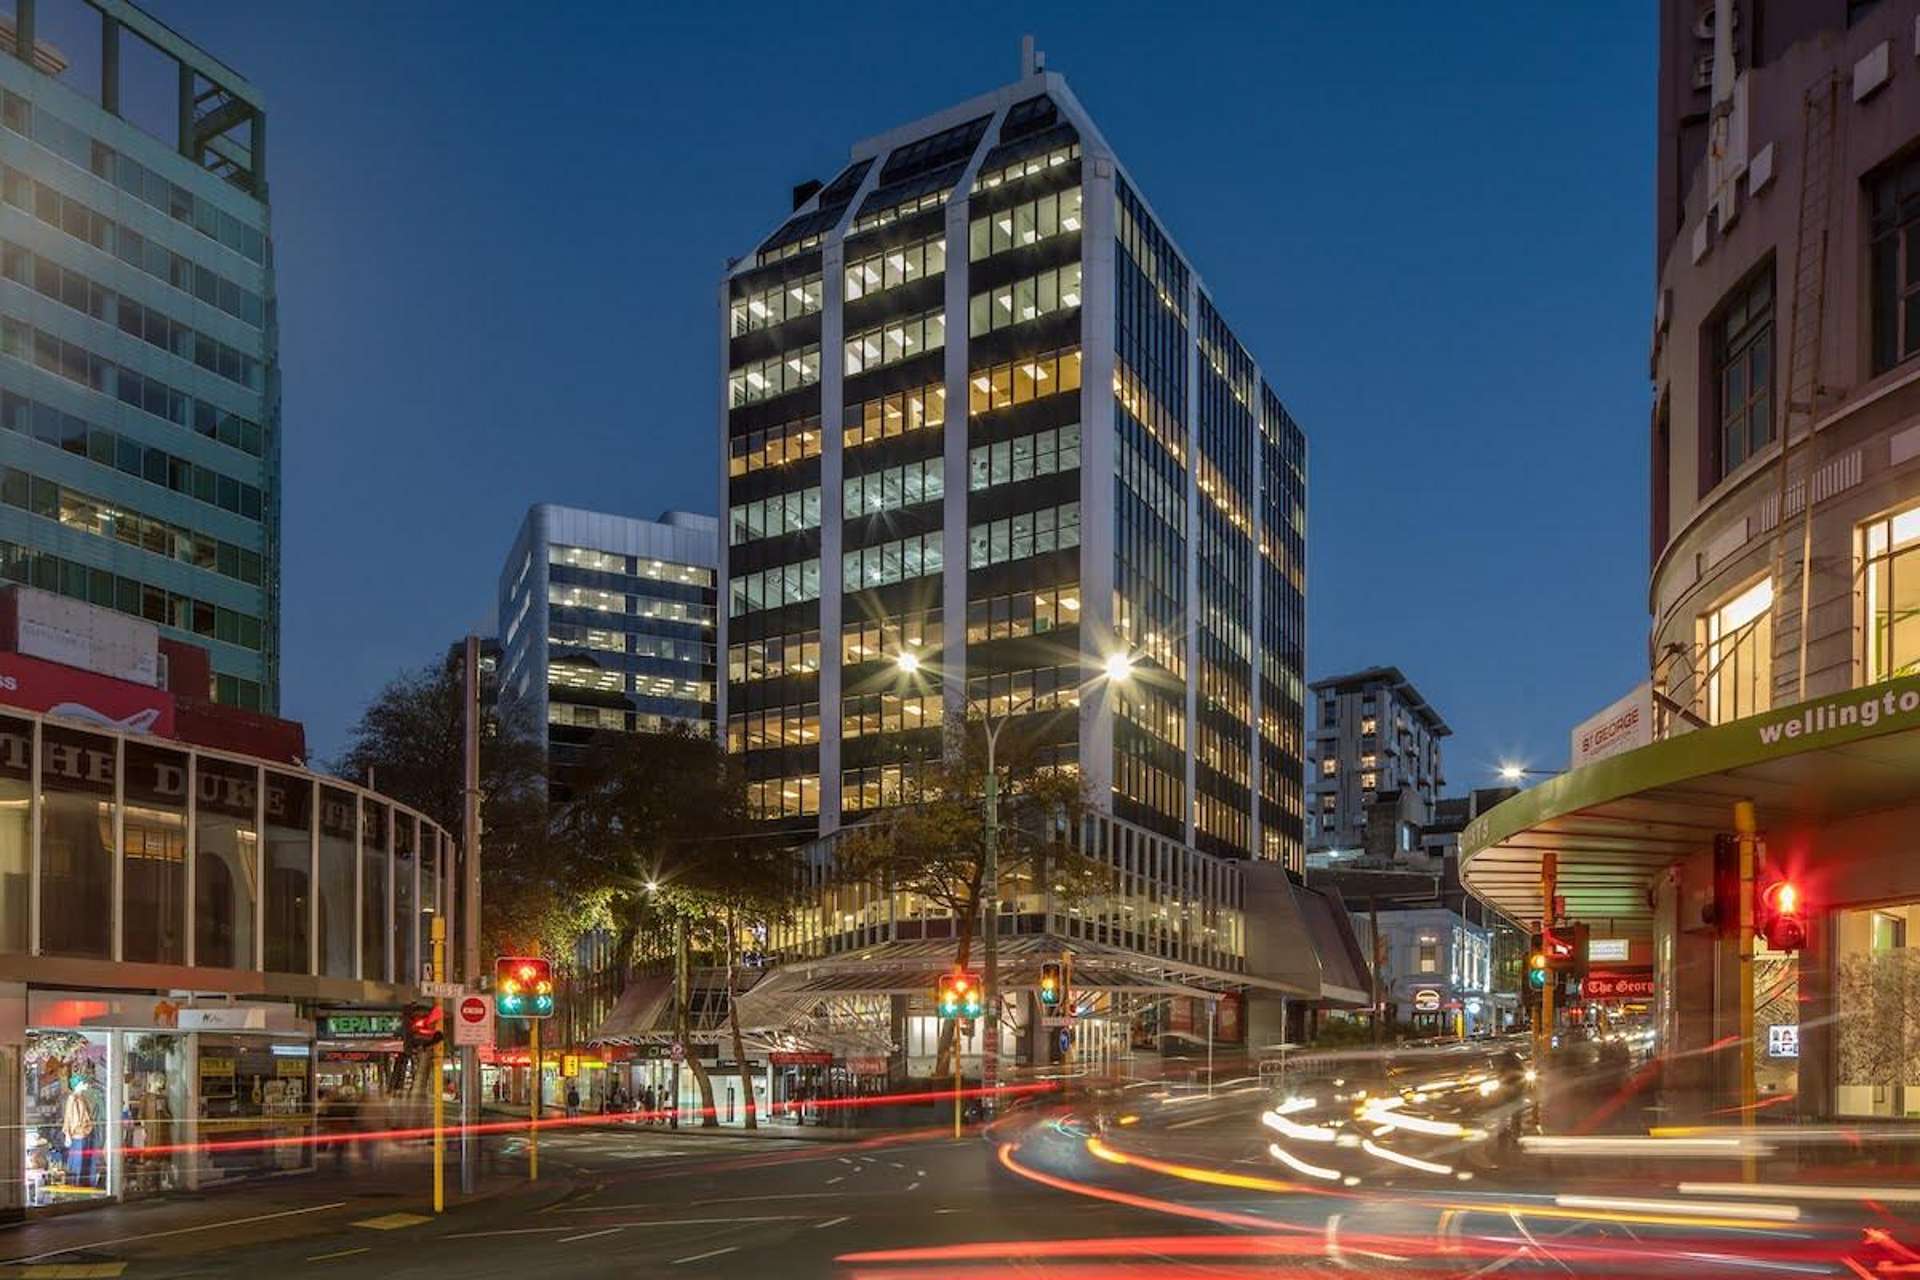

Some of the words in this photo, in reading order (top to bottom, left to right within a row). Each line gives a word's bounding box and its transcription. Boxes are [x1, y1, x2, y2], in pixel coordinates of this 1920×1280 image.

[1595, 707, 1639, 745] GEORGE
[1759, 690, 1920, 745] wellingto
[0, 732, 115, 784] THE
[153, 762, 286, 816] DUKE
[1588, 980, 1613, 994] The
